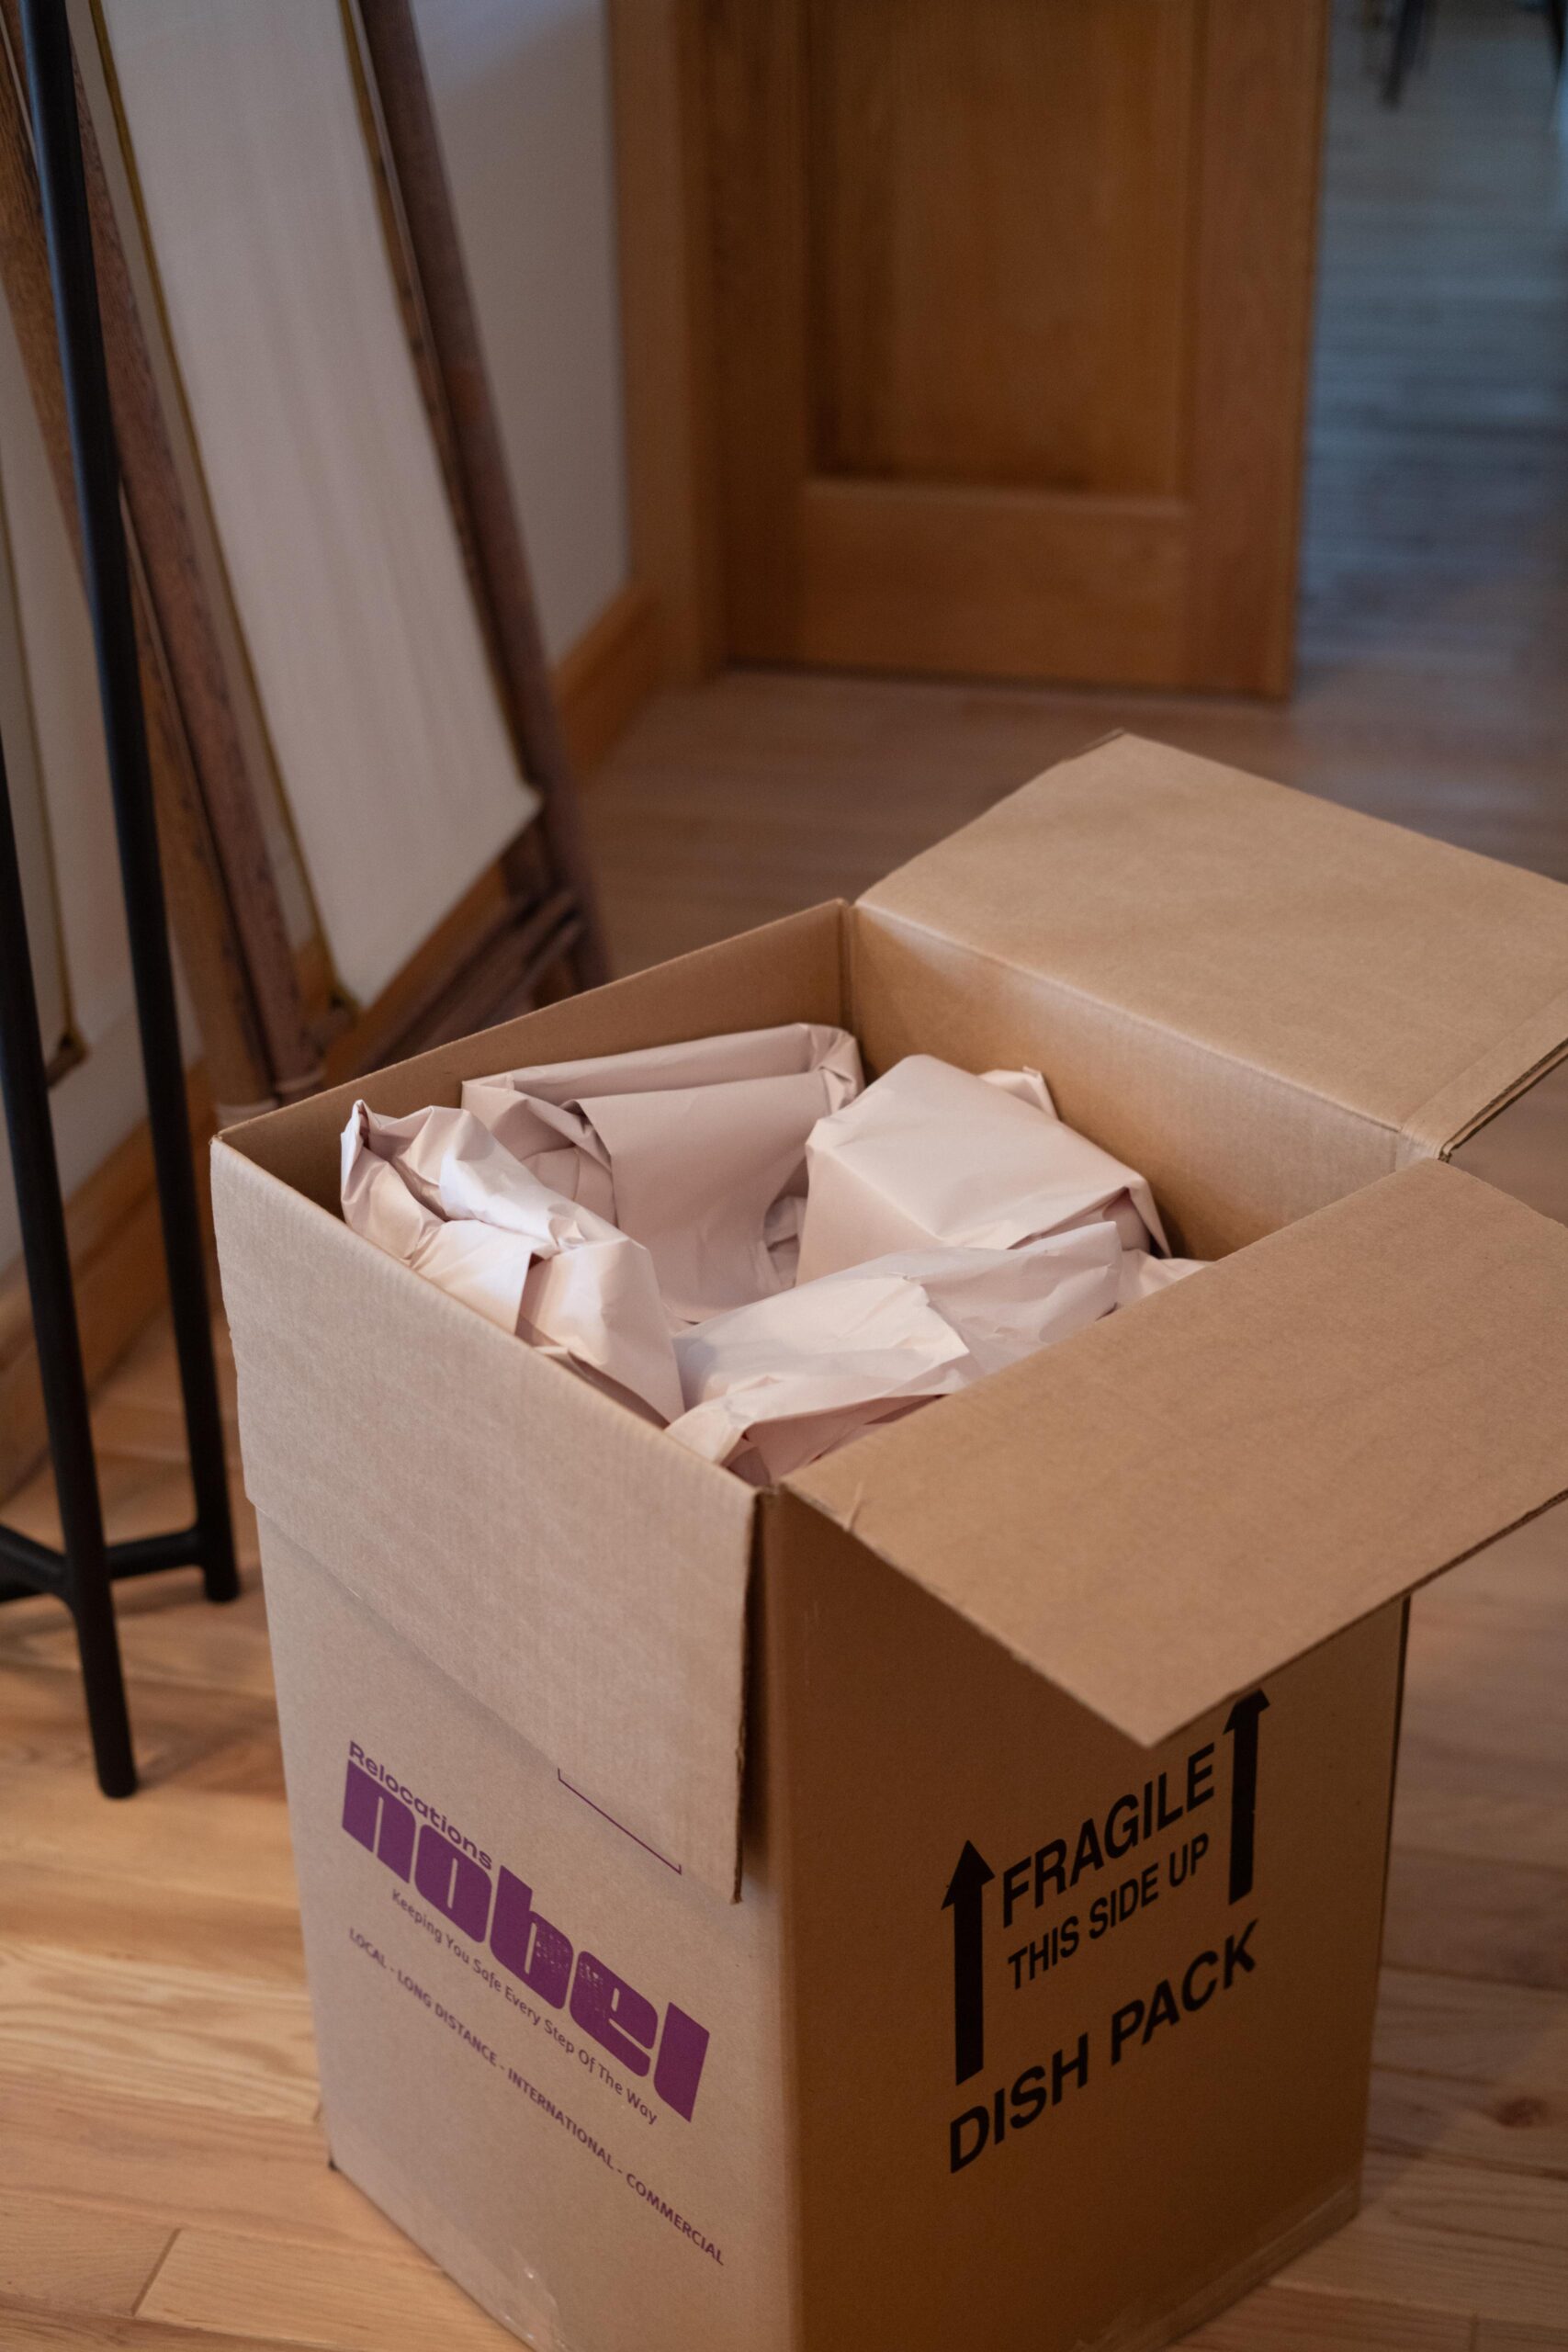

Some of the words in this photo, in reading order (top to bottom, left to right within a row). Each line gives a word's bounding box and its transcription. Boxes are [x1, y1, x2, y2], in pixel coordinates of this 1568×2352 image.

[349, 1740, 492, 1870] Relocations
[1003, 1741, 1215, 1929] FRAGILE
[1007, 1915, 1079, 1990] THIS
[1089, 1862, 1159, 1940] SIDE
[1168, 1832, 1210, 1889] UP
[342, 1758, 710, 2122] nobel
[391, 1888, 443, 1944] Keeping
[446, 1930, 470, 1964] You
[472, 1958, 502, 1993] Safe
[504, 1985, 541, 2026] Every
[544, 2019, 574, 2054] Step
[578, 2048, 596, 2074] Of
[599, 2064, 623, 2096] The
[626, 2087, 657, 2125] Way
[950, 2031, 1089, 2175] DISH
[1111, 1917, 1259, 2067] PACK
[349, 1928, 387, 1969] LOCAL
[398, 1969, 433, 2009] LONG
[435, 2002, 498, 2067] DISTANCE
[508, 2067, 615, 2171] INTERNATIONAL
[626, 2172, 725, 2267] COMMERCIAL
